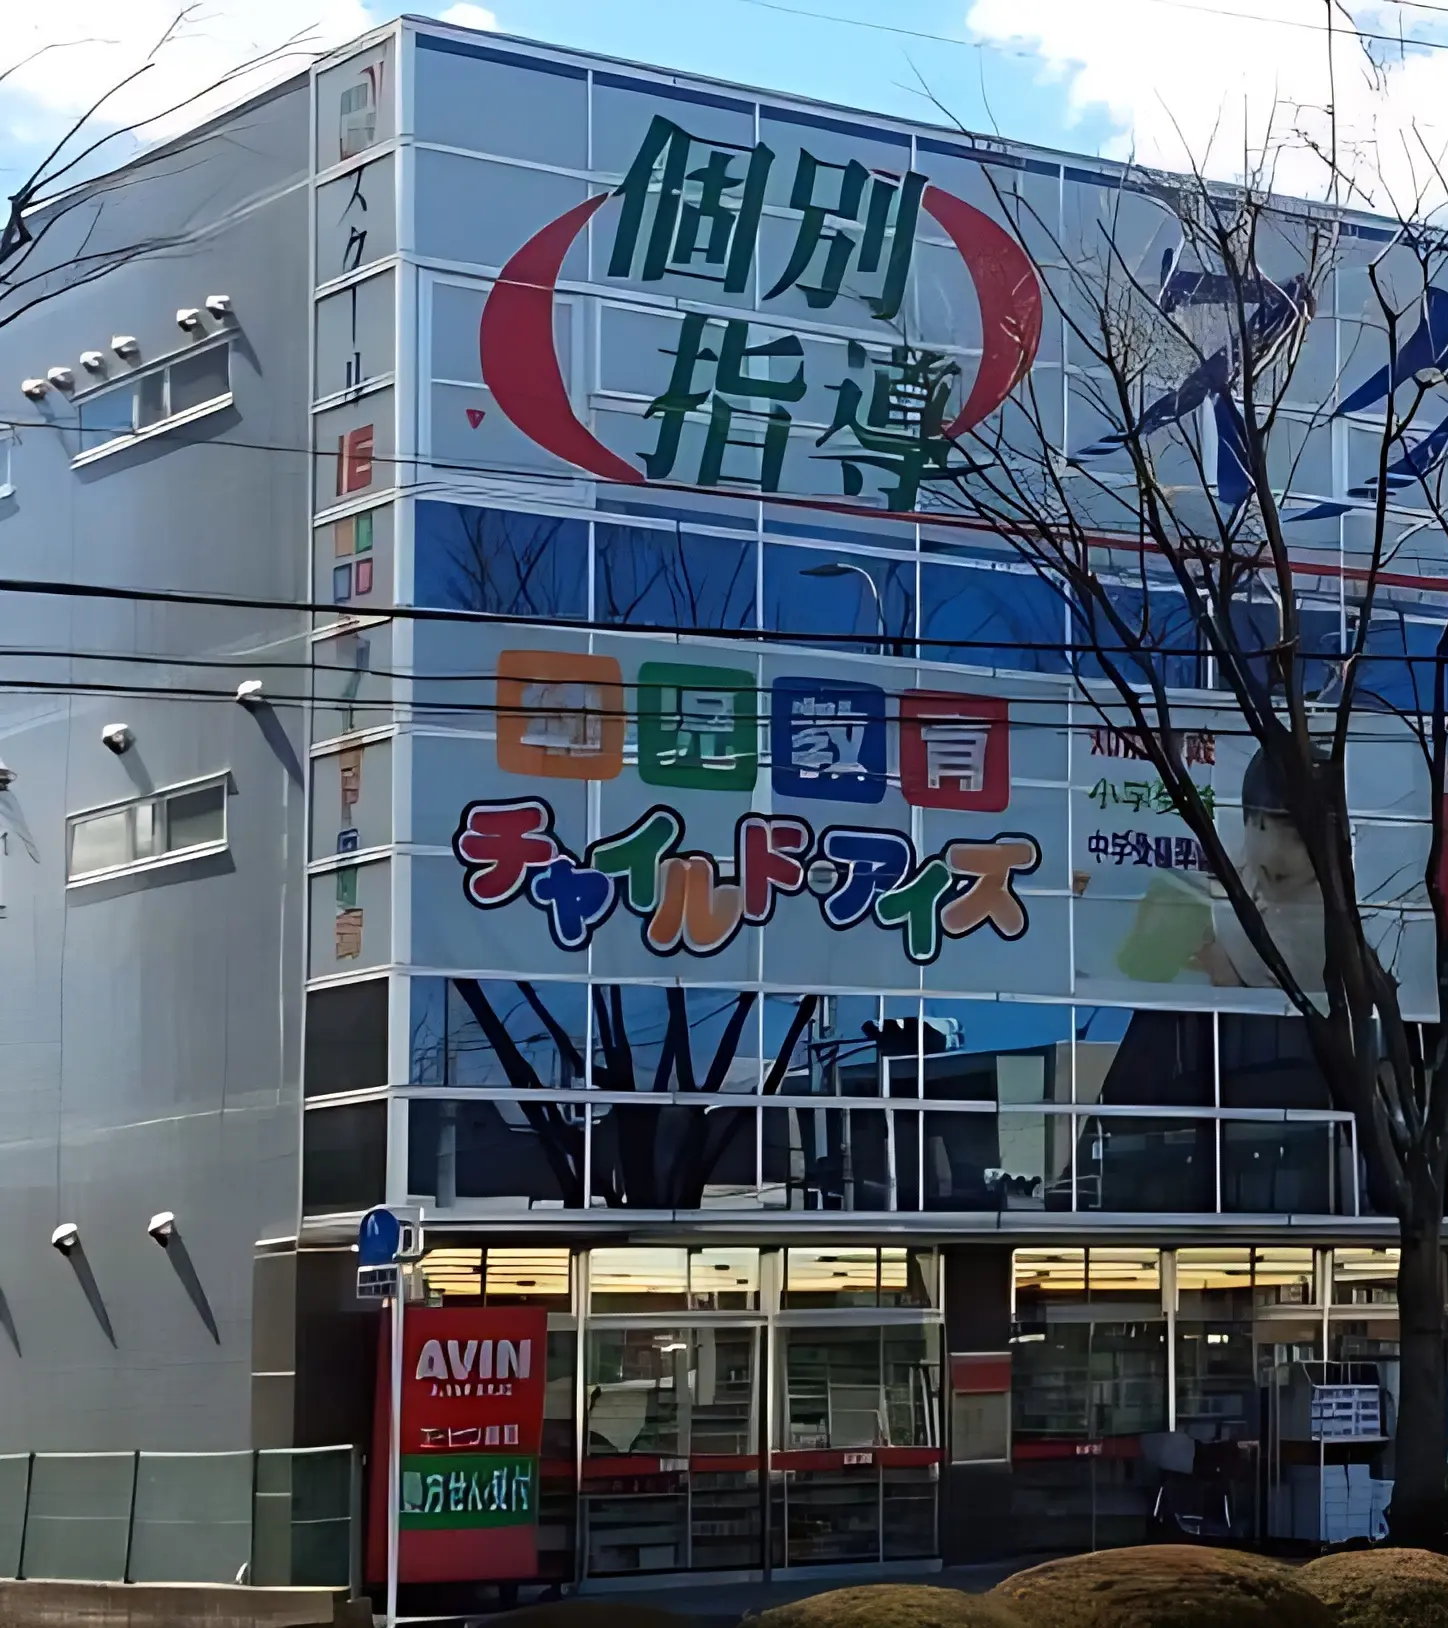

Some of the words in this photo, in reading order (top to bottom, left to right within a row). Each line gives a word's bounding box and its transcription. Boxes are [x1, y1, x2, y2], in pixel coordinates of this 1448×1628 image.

[608, 114, 929, 320] 個別
[638, 312, 994, 512] 指導
[415, 1339, 532, 1380] AVIN
